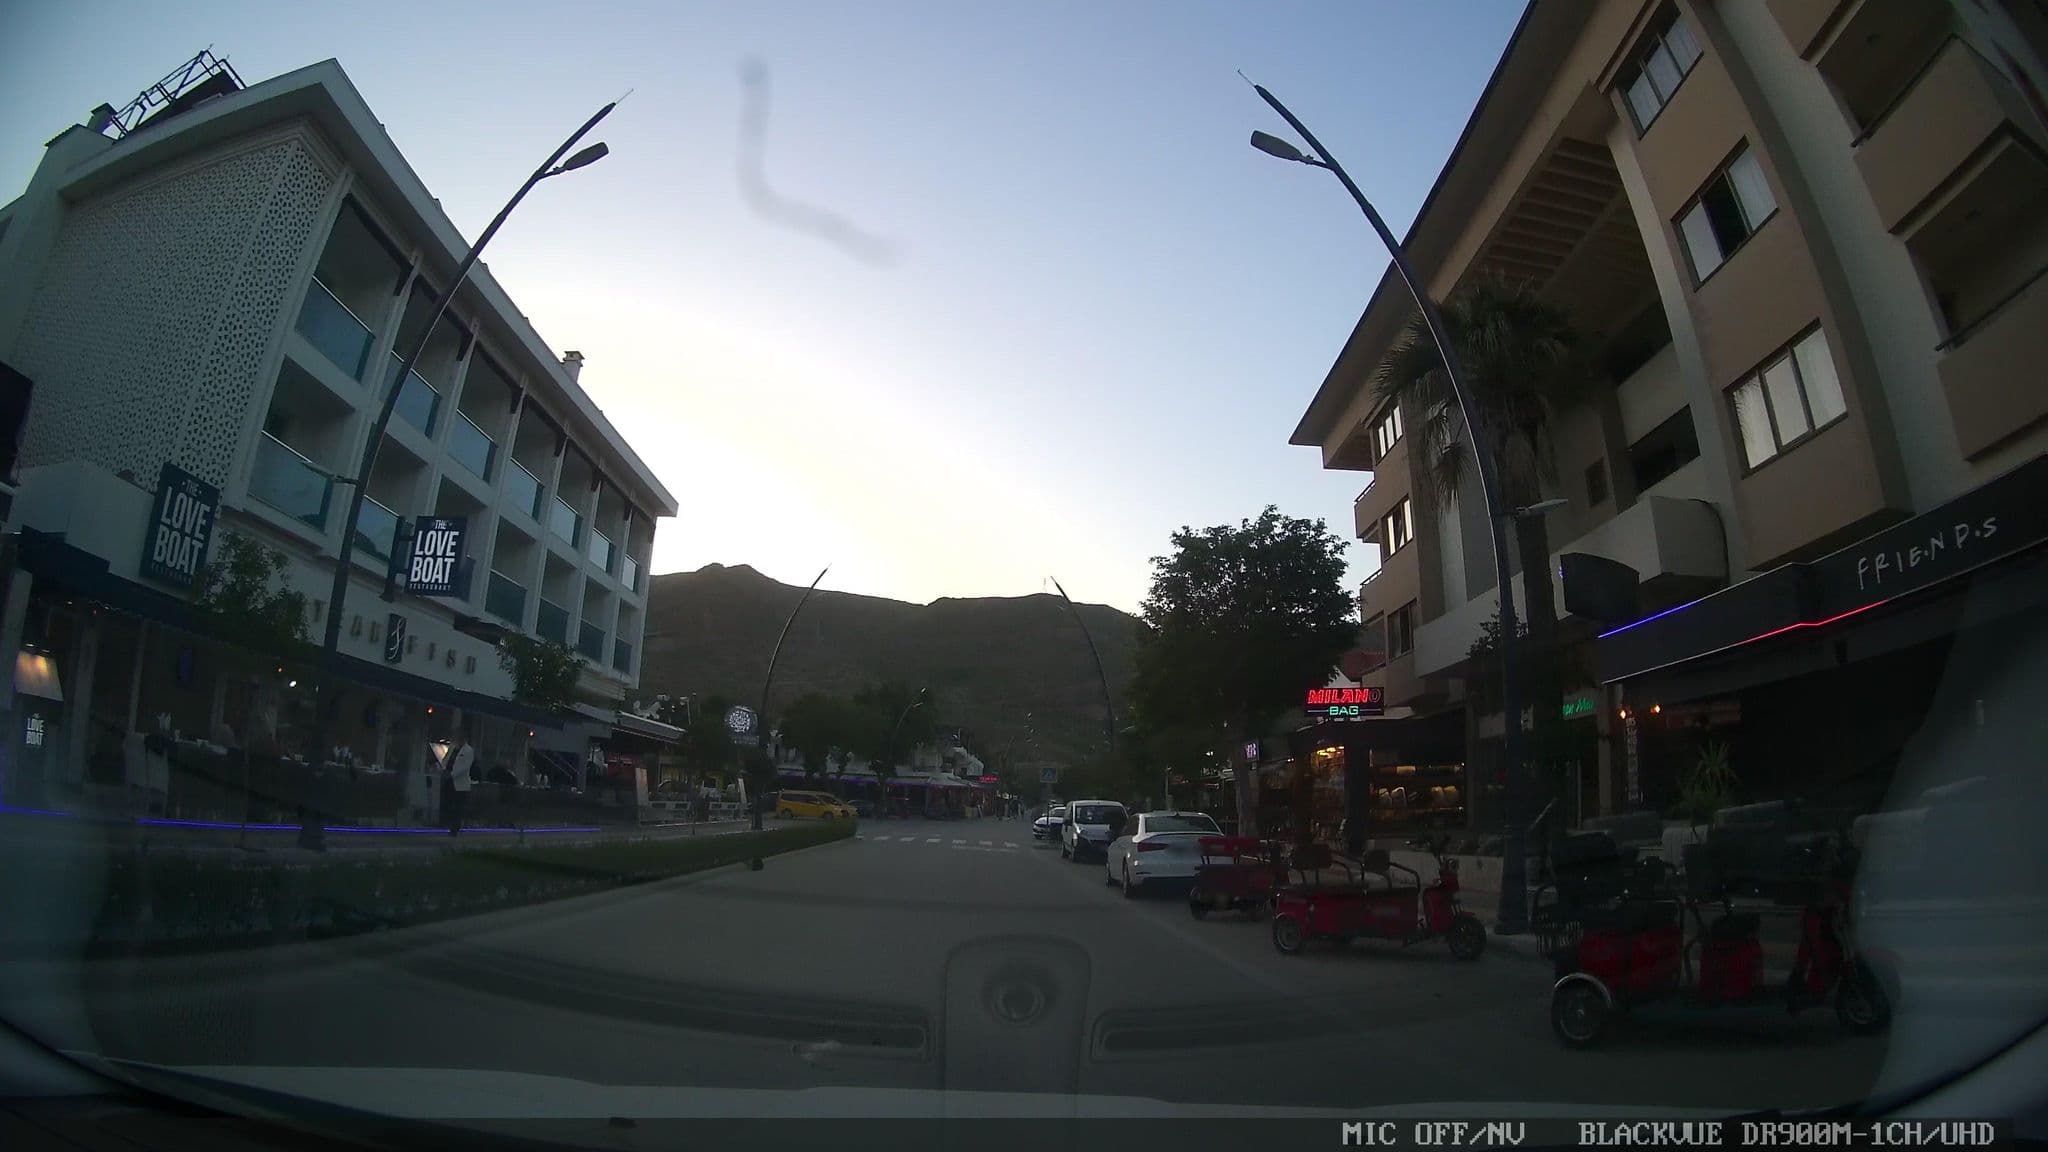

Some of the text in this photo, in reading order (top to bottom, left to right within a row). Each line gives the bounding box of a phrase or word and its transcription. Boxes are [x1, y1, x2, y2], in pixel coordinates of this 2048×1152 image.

[161, 486, 211, 541] LOVE
[434, 519, 447, 530] THE
[153, 524, 204, 576] BOAT
[414, 530, 460, 557] LOVE
[410, 556, 456, 584] BOAT
[1307, 688, 1381, 704] MILANO
[1329, 706, 1359, 716] BAG
